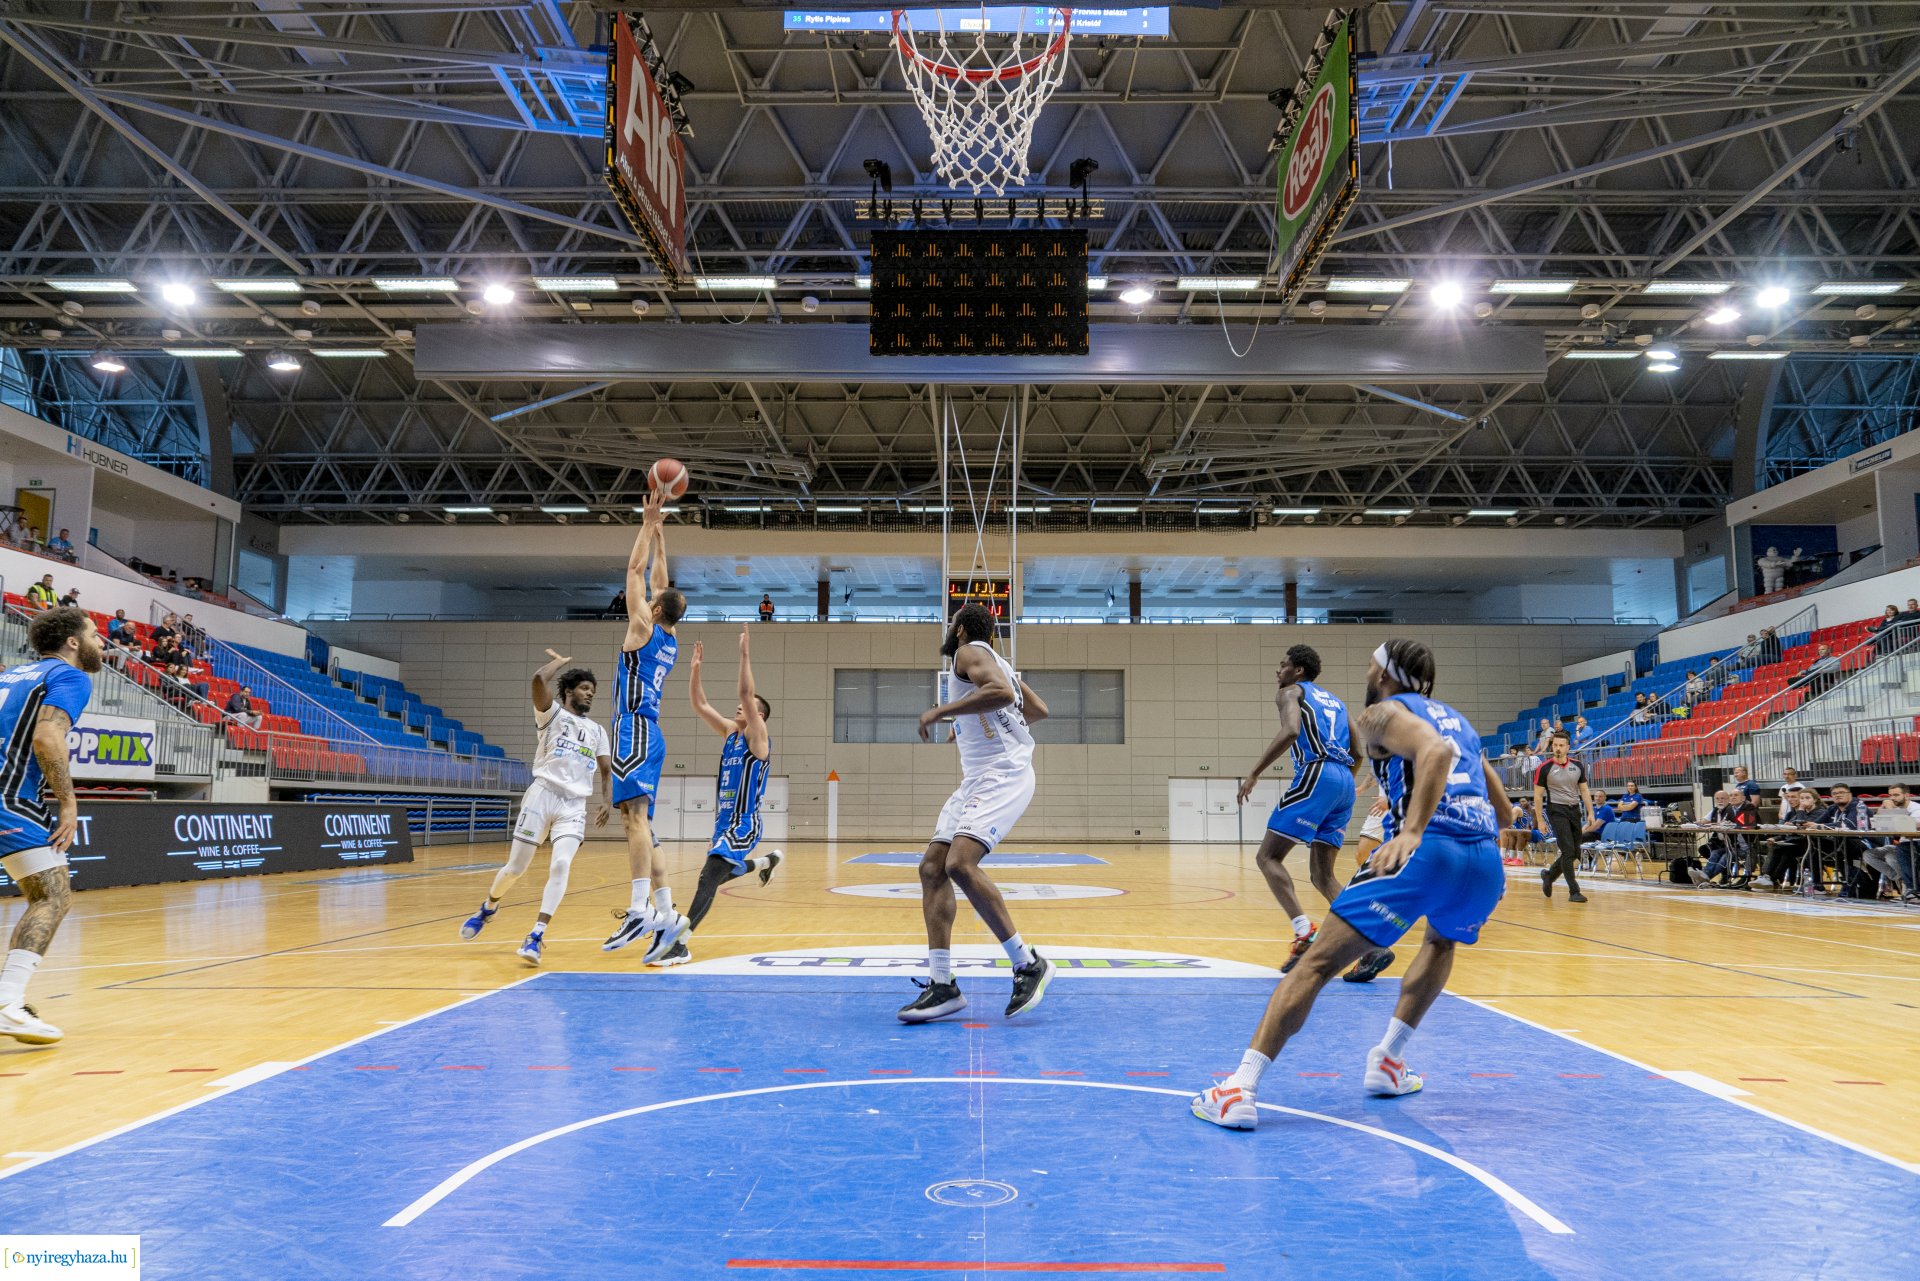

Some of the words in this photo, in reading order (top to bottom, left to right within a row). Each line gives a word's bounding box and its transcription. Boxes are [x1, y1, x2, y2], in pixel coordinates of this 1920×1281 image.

[805, 15, 824, 24] Rytis
[1289, 97, 1325, 209] Reál
[83, 447, 128, 475] HÜBNER
[653, 664, 667, 691] 8
[1324, 708, 1337, 740] 7
[66, 730, 152, 763] PPMIX
[174, 814, 273, 842] CONTINENT
[324, 814, 391, 837] CONTINENT
[198, 845, 221, 857] WINE
[223, 845, 231, 856] &
[231, 843, 261, 855] COFFEE
[340, 840, 356, 849] WINE
[357, 840, 363, 849] &
[363, 839, 383, 848] COFFEE
